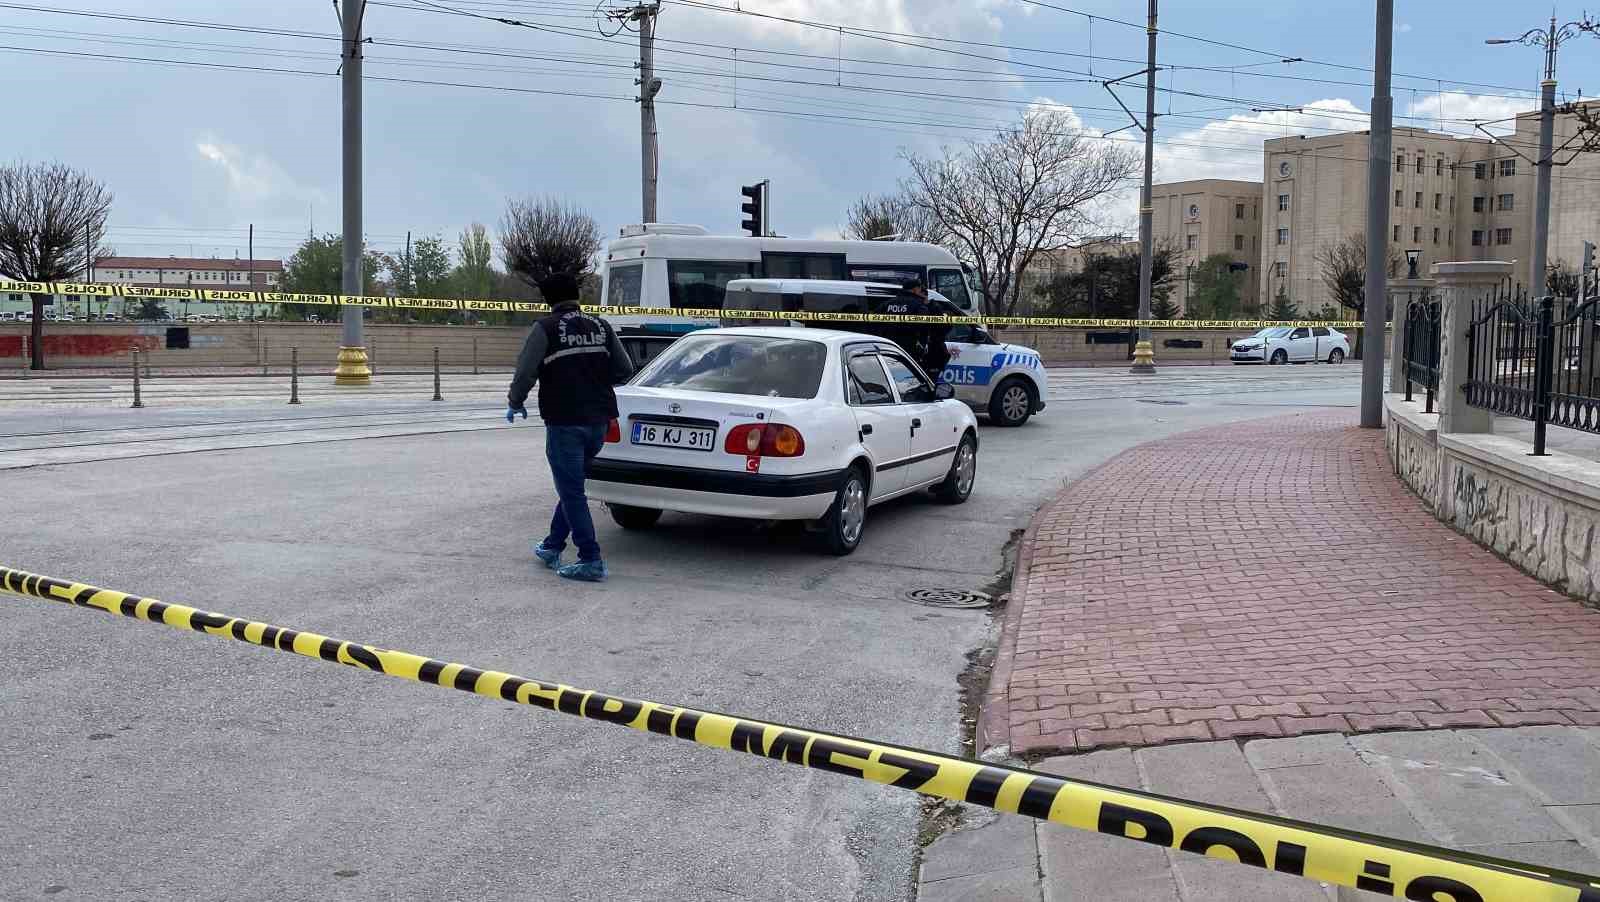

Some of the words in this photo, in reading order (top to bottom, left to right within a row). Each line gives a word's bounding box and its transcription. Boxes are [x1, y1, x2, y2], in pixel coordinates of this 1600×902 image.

[642, 426, 656, 442] 16
[663, 428, 682, 444] KJ
[688, 431, 711, 447] 311
